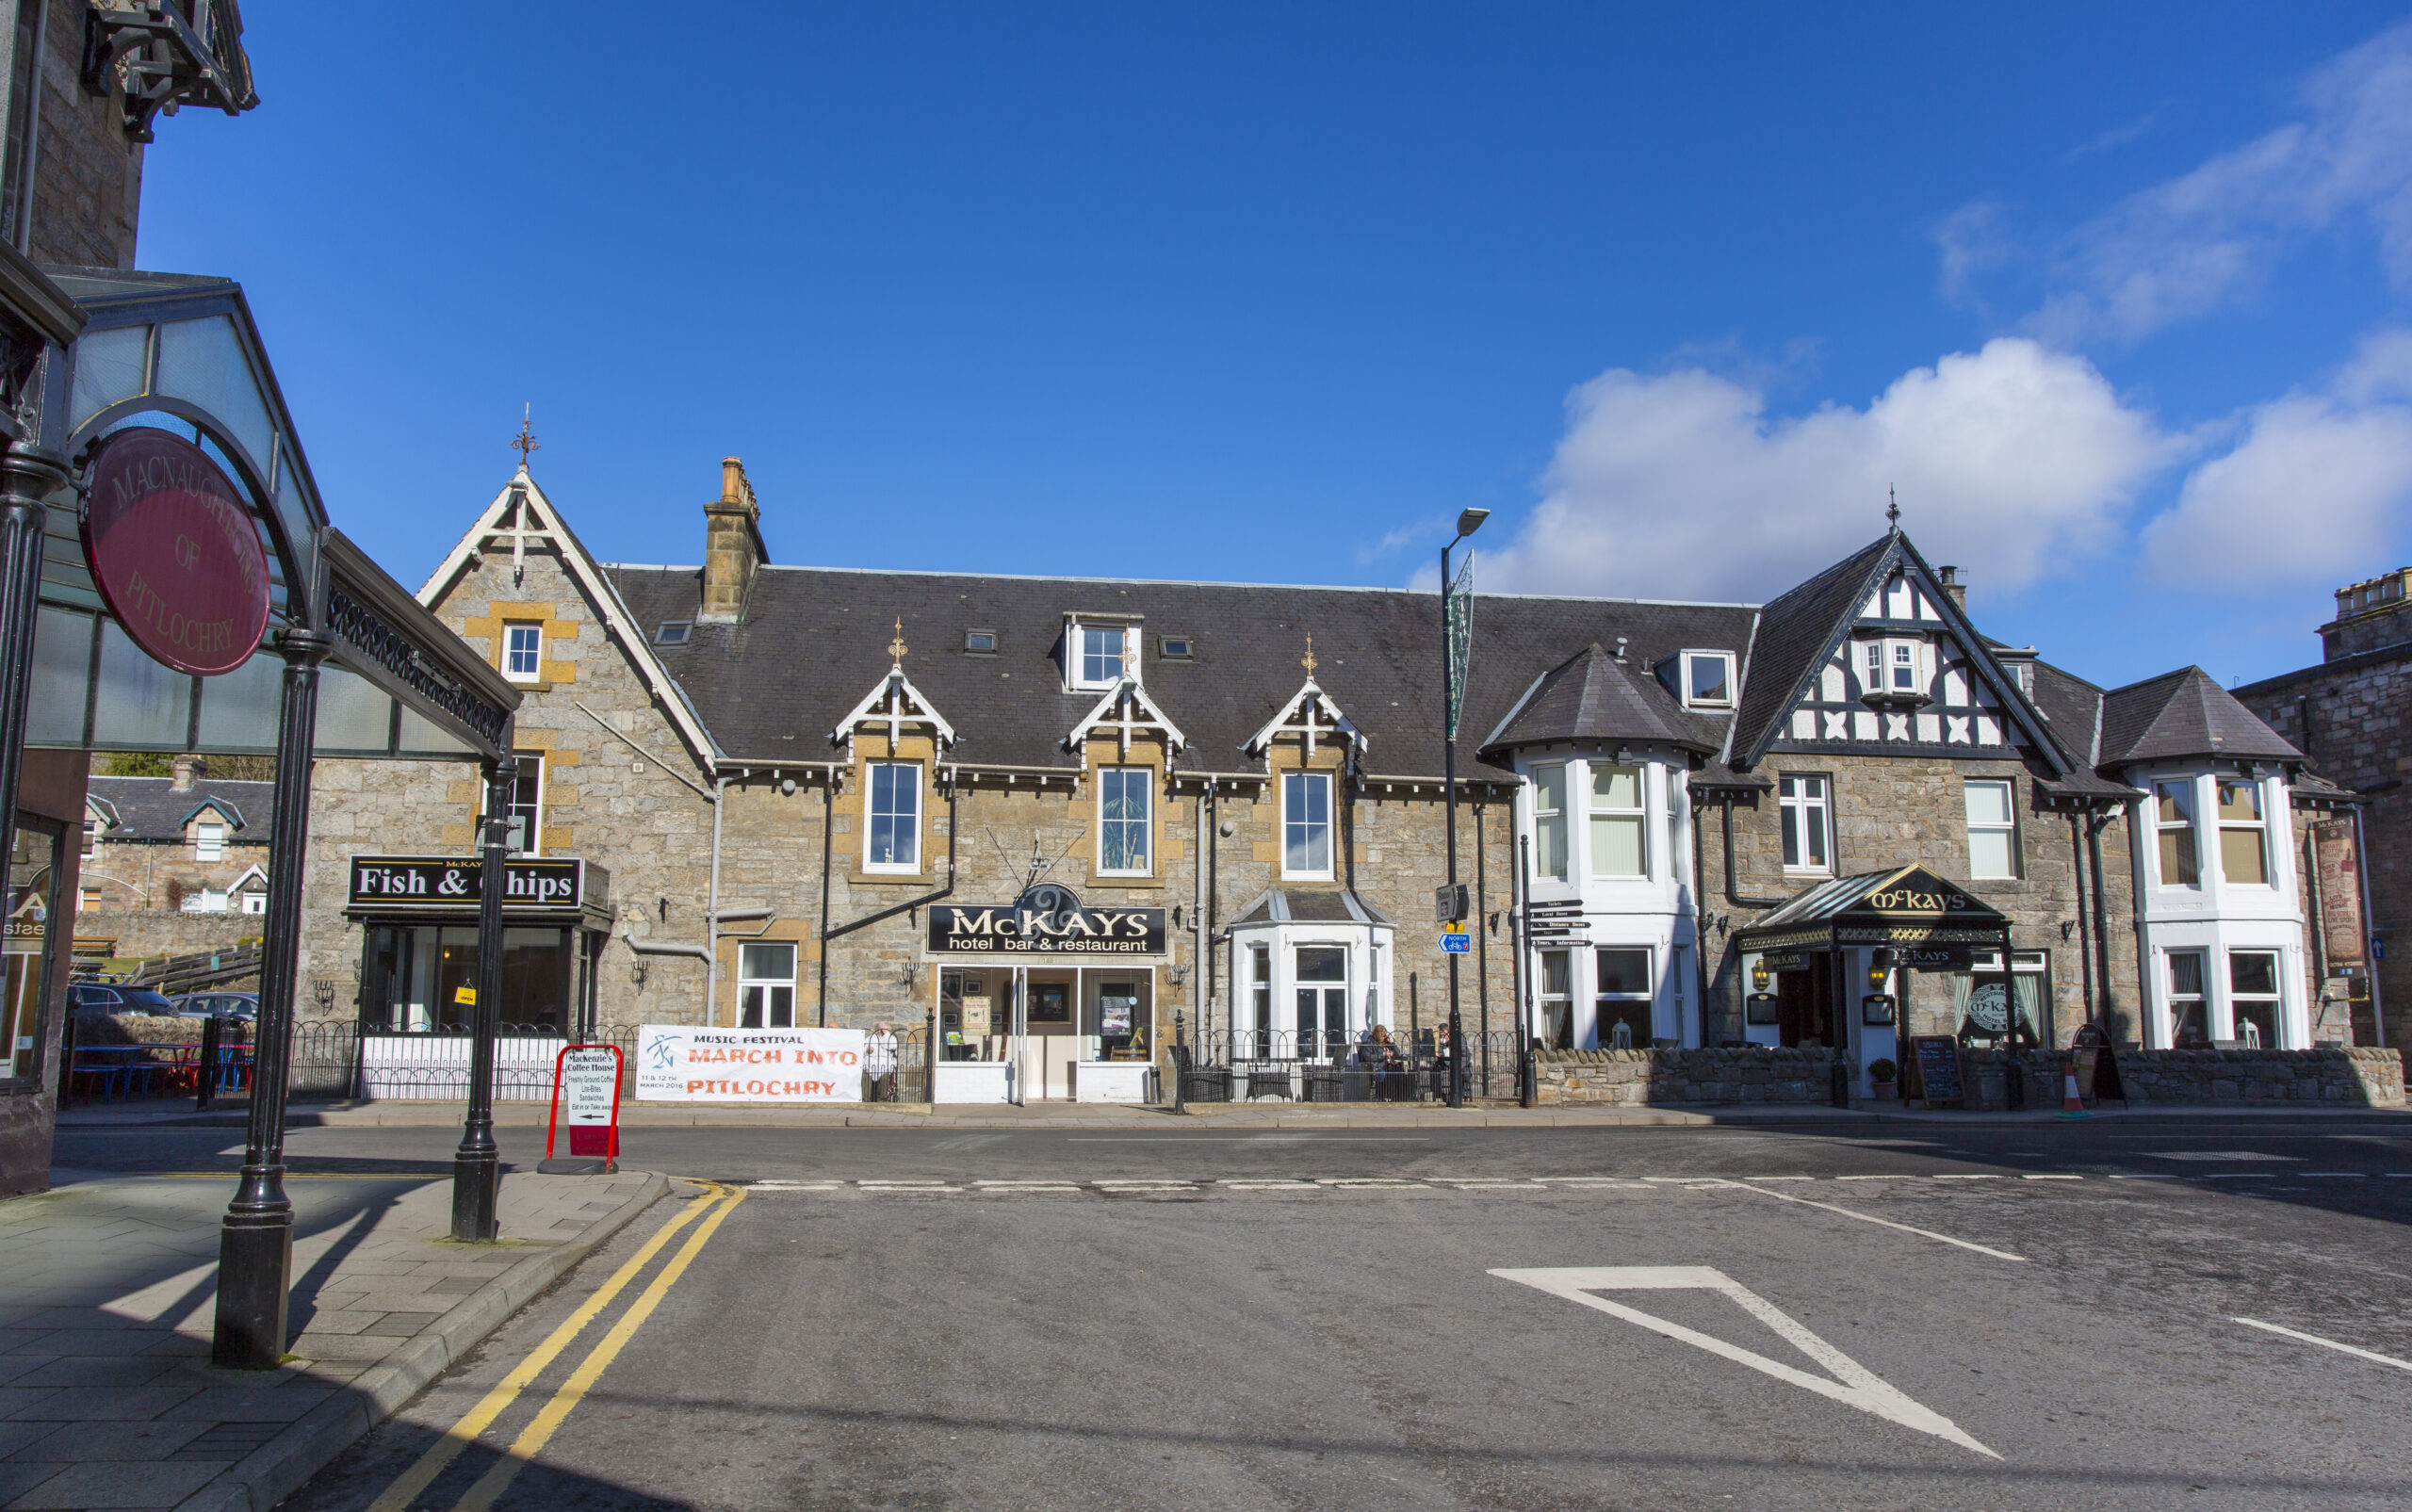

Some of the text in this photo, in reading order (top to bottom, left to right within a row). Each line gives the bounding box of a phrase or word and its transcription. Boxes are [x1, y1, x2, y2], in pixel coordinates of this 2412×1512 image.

[112, 455, 259, 595] MACNAUGHTONS
[174, 534, 202, 573] OF
[125, 565, 235, 654] PITLOCHRY
[356, 868, 572, 902] Fish & hips
[947, 908, 1149, 936] McKAYS
[949, 937, 1148, 951] hotel bar & restaurant
[693, 1035, 805, 1045] MUSIC FESTIVAL
[689, 1049, 857, 1066] MARCH INTO
[568, 1076, 583, 1084] Freshly
[687, 1080, 836, 1096] PITLOCHRY
